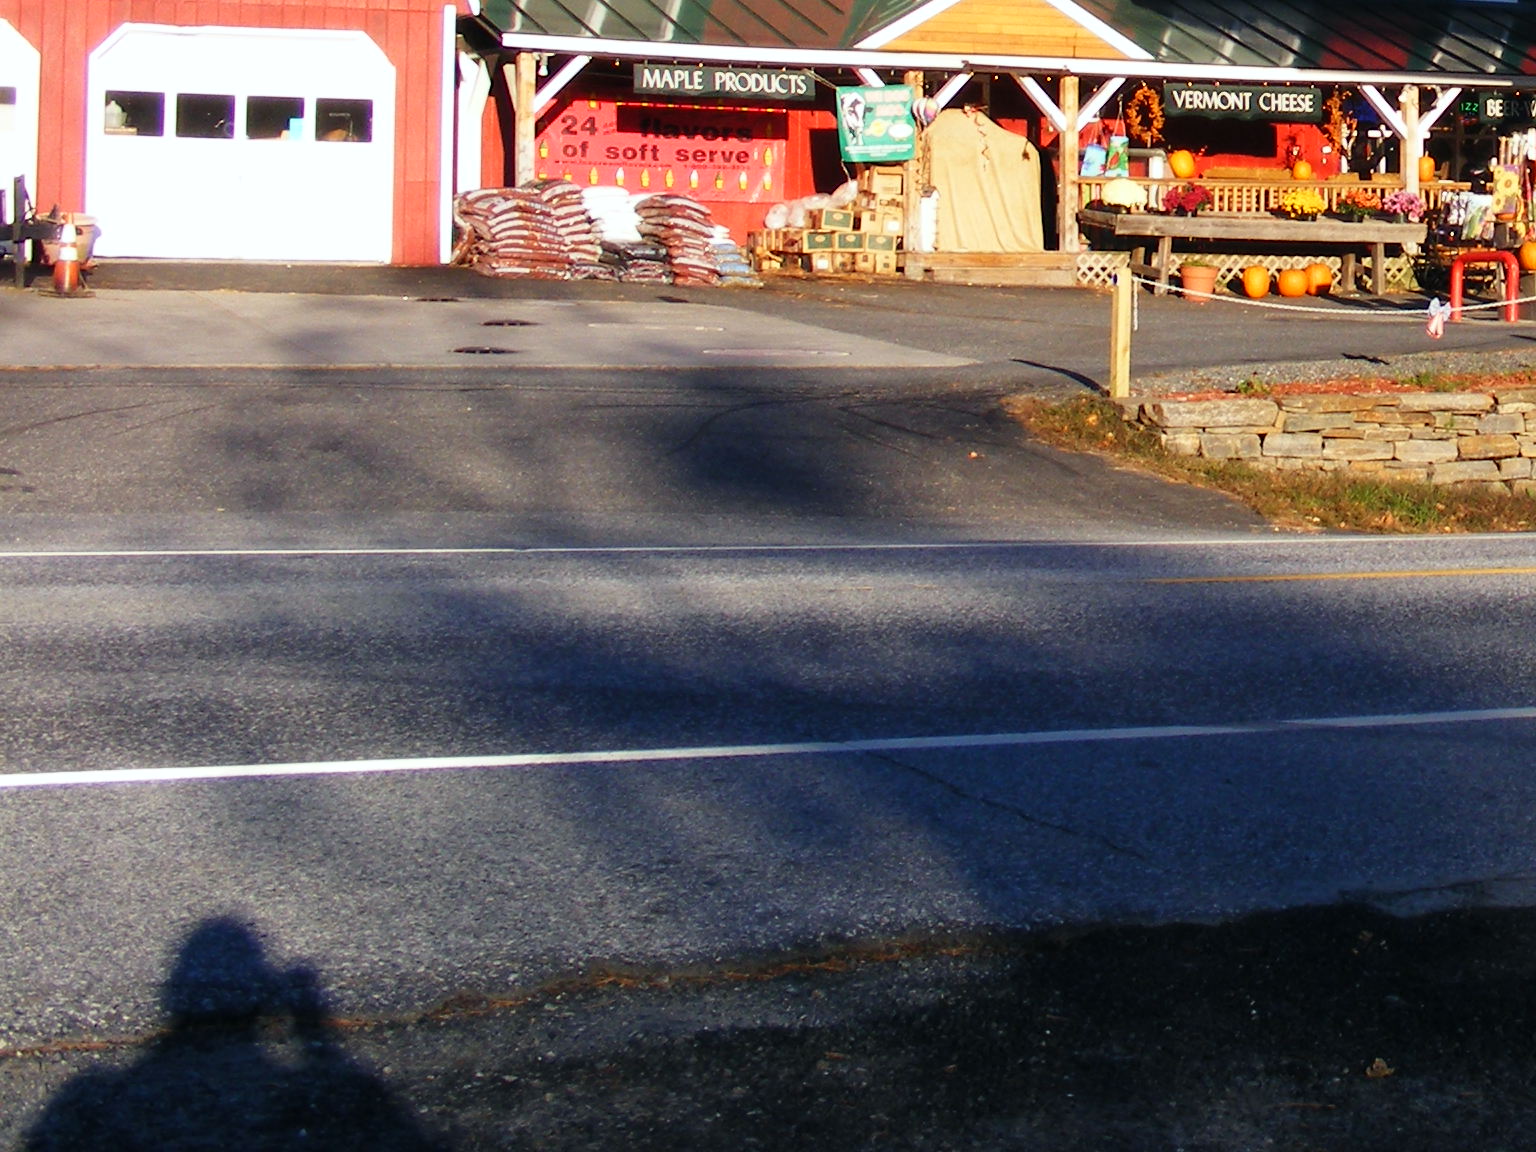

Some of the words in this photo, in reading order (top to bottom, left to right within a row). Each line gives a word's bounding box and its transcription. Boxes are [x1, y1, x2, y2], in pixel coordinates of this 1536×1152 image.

[642, 68, 704, 90] MAPLE
[714, 71, 807, 95] PRODUCTS
[1172, 90, 1252, 111] VERMONT
[1258, 92, 1314, 113] CHEESE
[561, 115, 598, 136] 24
[640, 117, 753, 143] flavors
[562, 141, 589, 158] of
[605, 144, 660, 162] soft
[676, 148, 750, 164] serve
